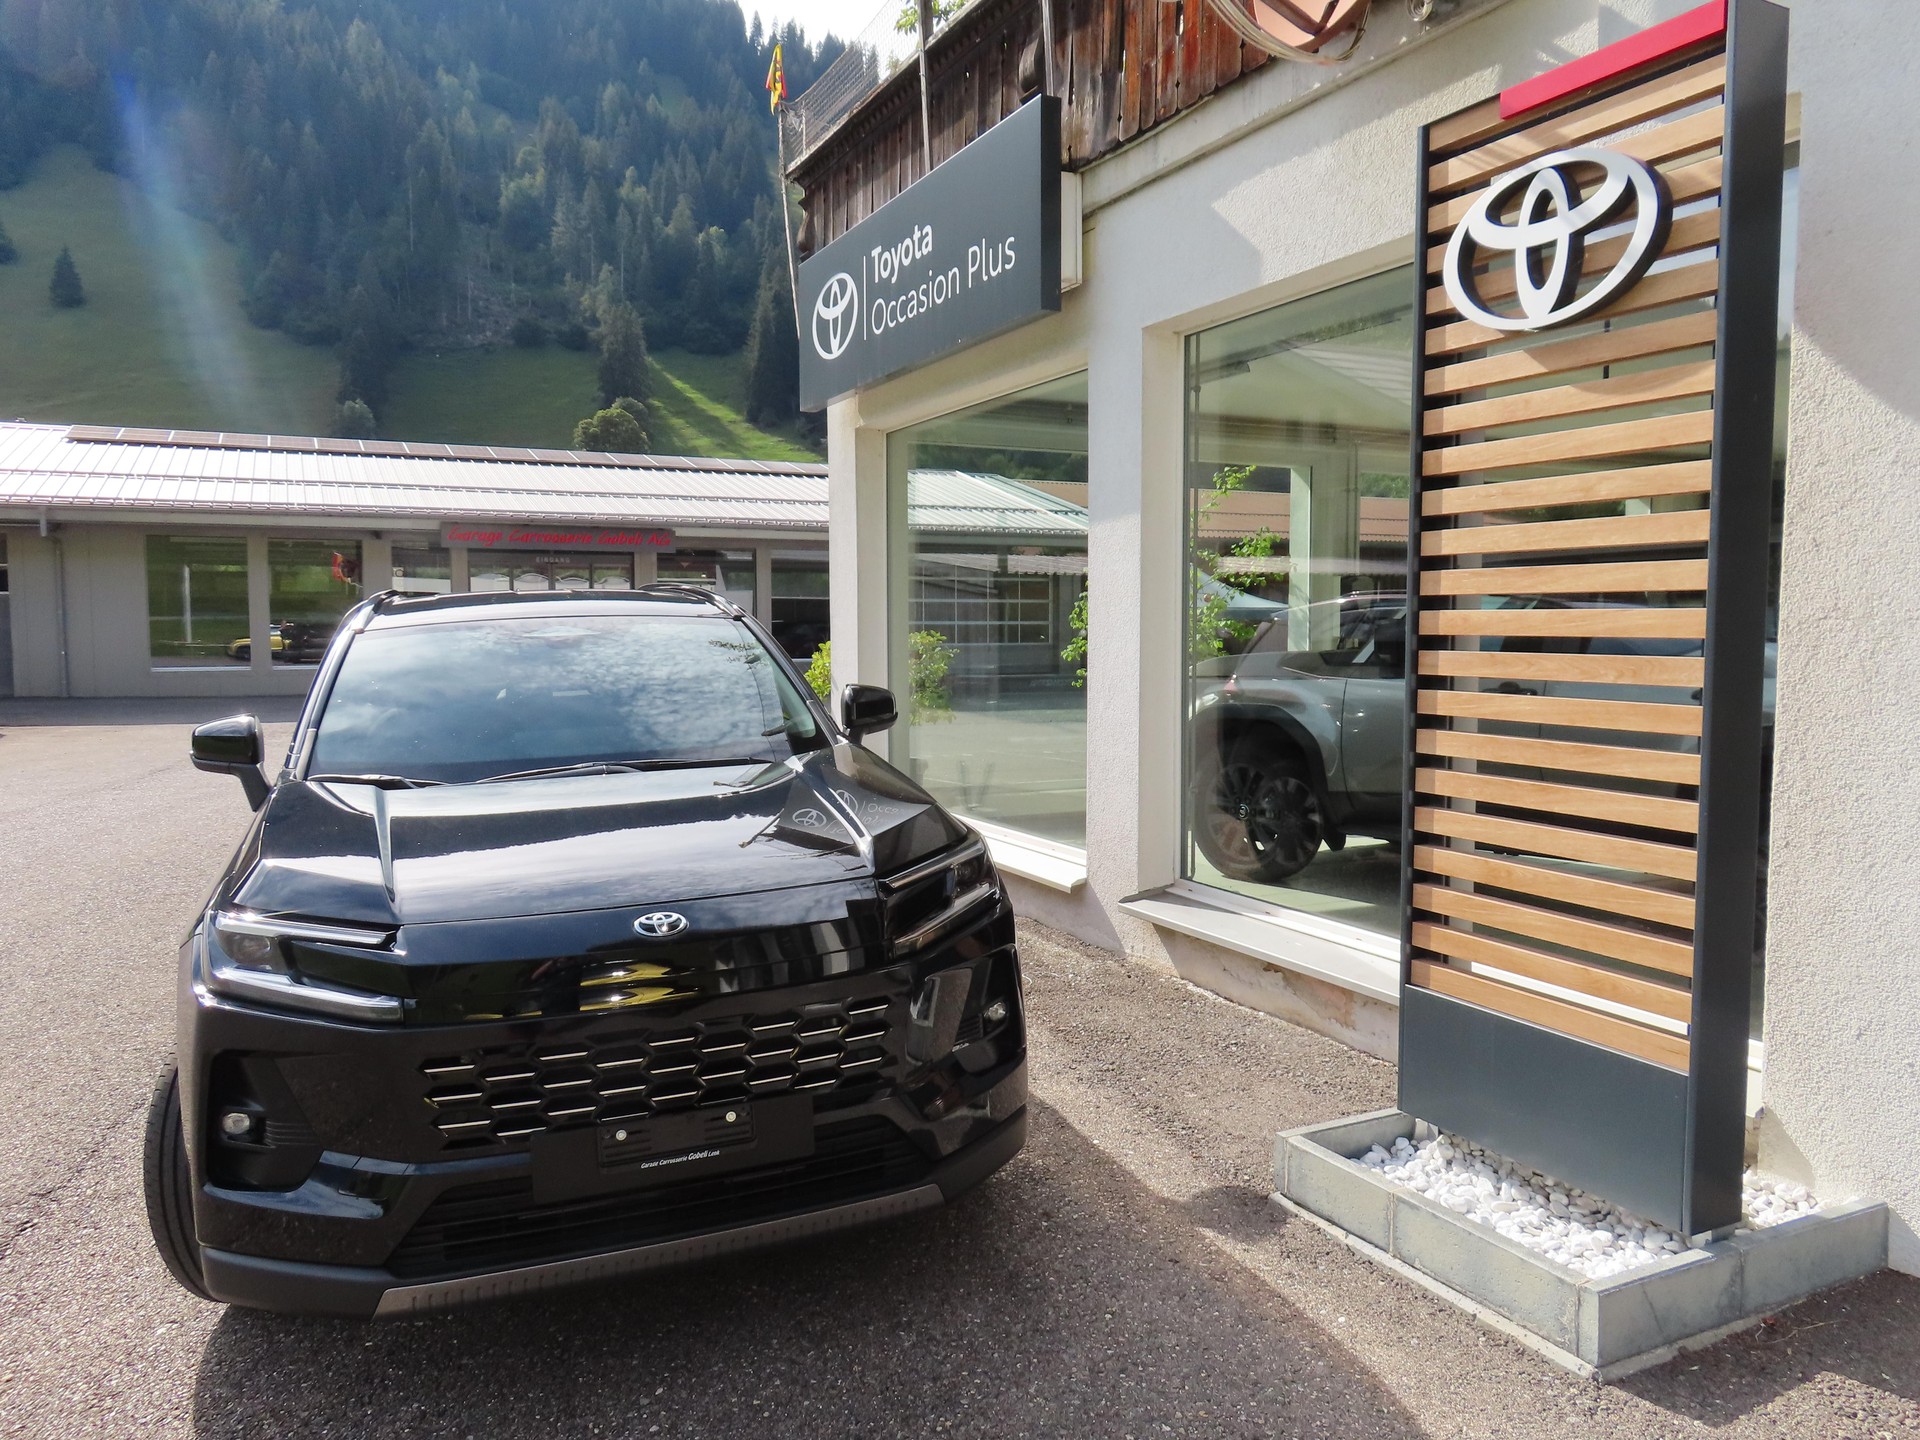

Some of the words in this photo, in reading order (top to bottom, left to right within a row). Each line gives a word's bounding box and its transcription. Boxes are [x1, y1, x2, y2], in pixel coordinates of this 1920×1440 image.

[871, 224, 933, 284] Toyota
[871, 266, 960, 335] Occasion
[967, 236, 1016, 289] Plus
[447, 527, 503, 547] Garage
[646, 532, 671, 546] AG
[688, 1150, 708, 1161] Gobeli
